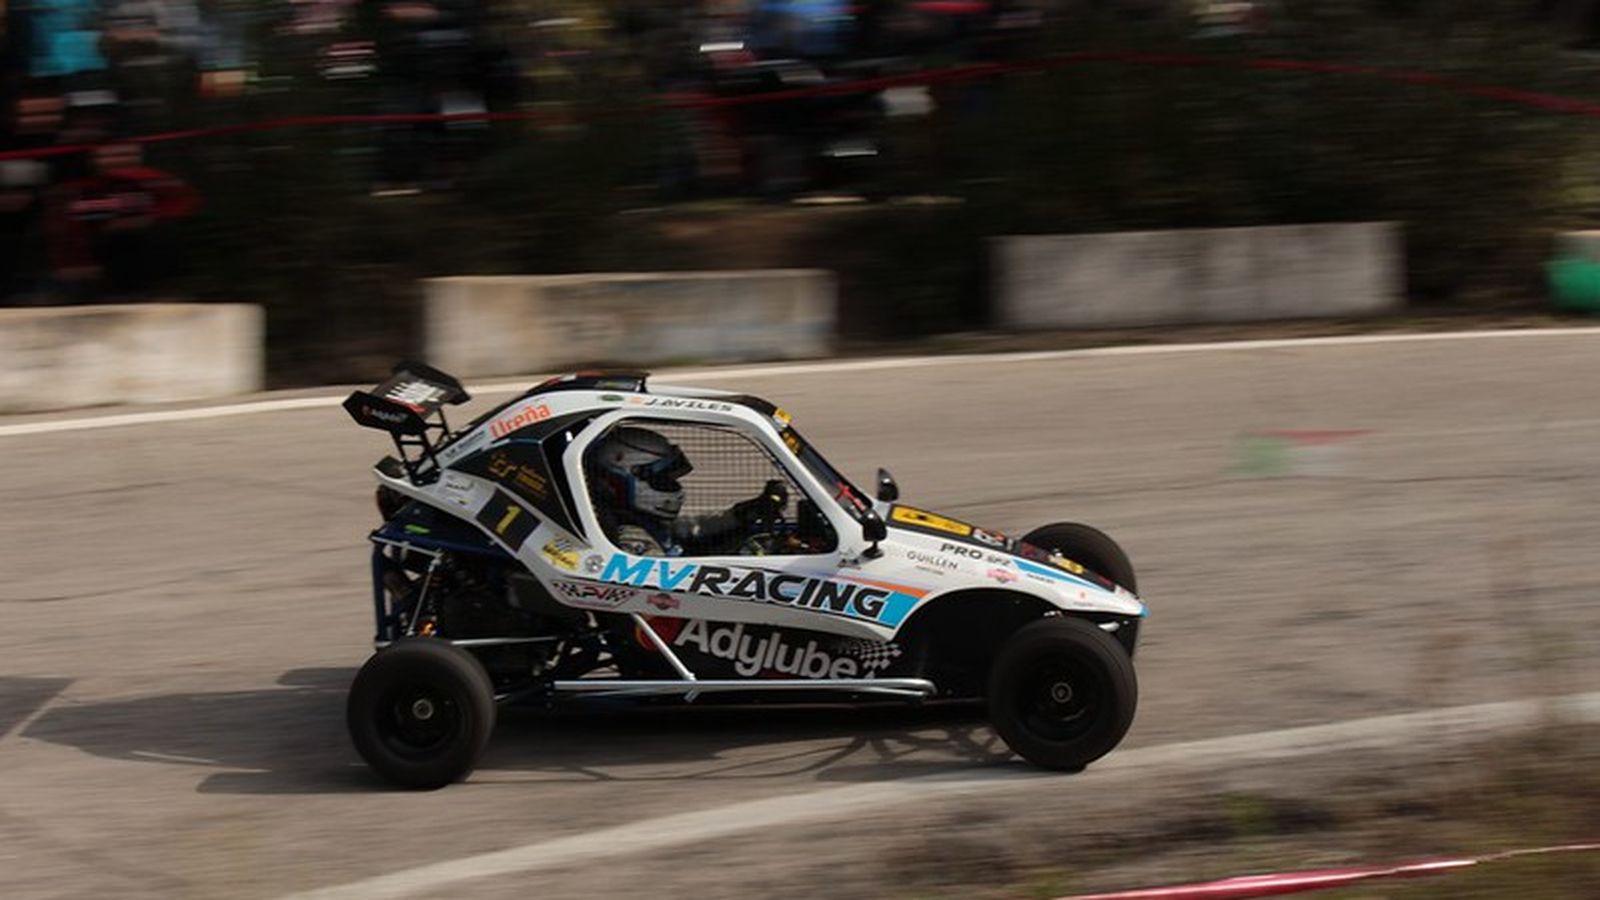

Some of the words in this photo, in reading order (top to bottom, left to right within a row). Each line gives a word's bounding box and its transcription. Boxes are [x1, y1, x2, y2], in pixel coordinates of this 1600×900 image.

[496, 505, 522, 536] 1
[906, 550, 959, 570] GUILLEN
[940, 543, 983, 560] PRO
[674, 618, 858, 680] Adylube
